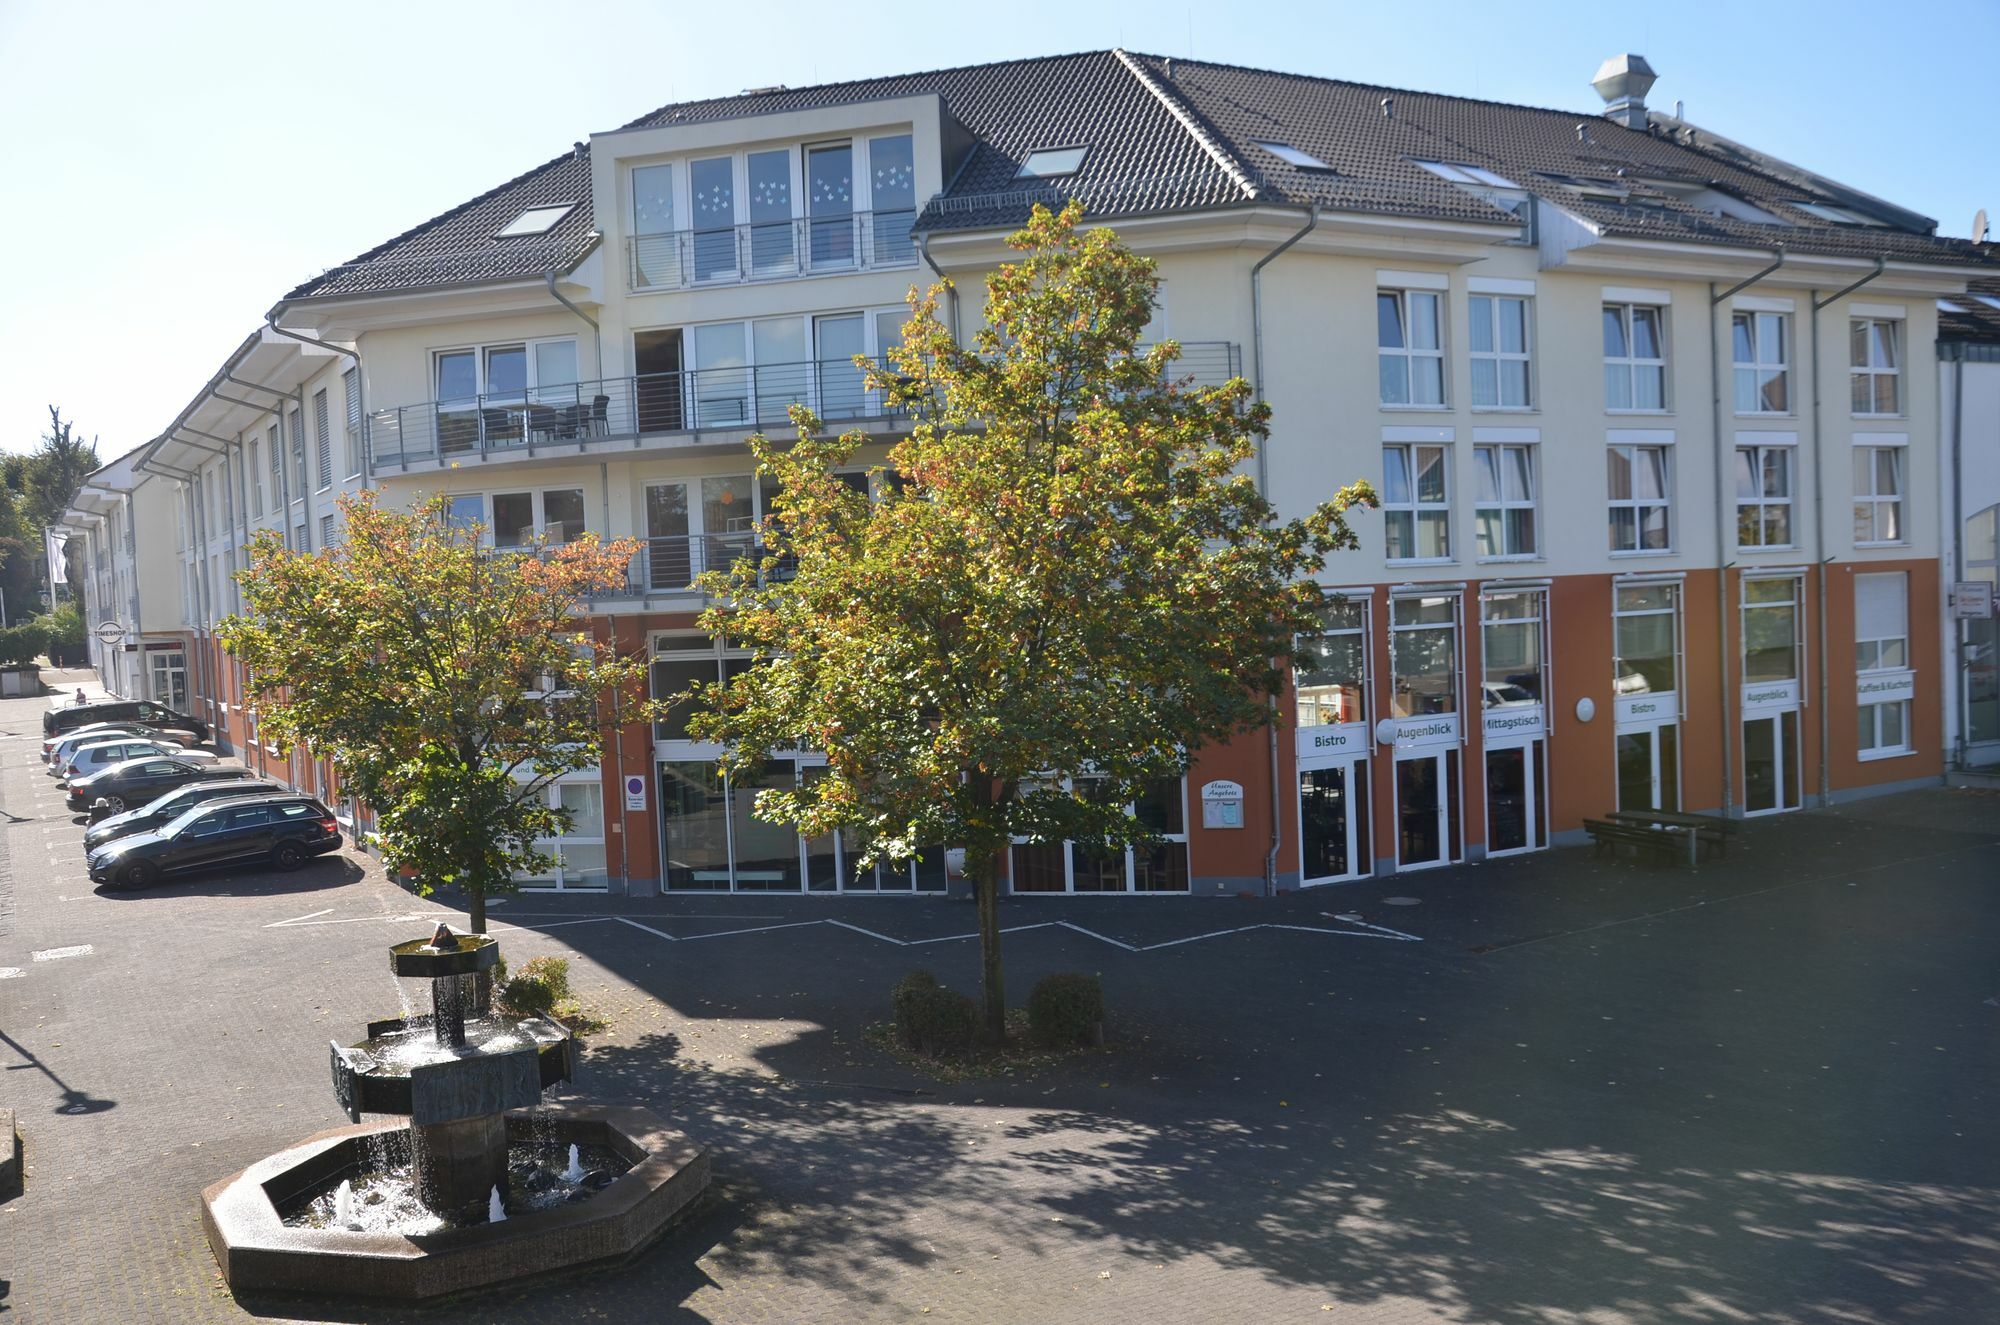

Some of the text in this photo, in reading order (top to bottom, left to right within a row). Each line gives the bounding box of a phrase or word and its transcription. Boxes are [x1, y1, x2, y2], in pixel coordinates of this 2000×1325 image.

[1747, 689, 1788, 703] Augenblick
[1631, 704, 1656, 714] Bistro
[1397, 723, 1452, 740] Augenblick
[1315, 735, 1346, 747] Bistro
